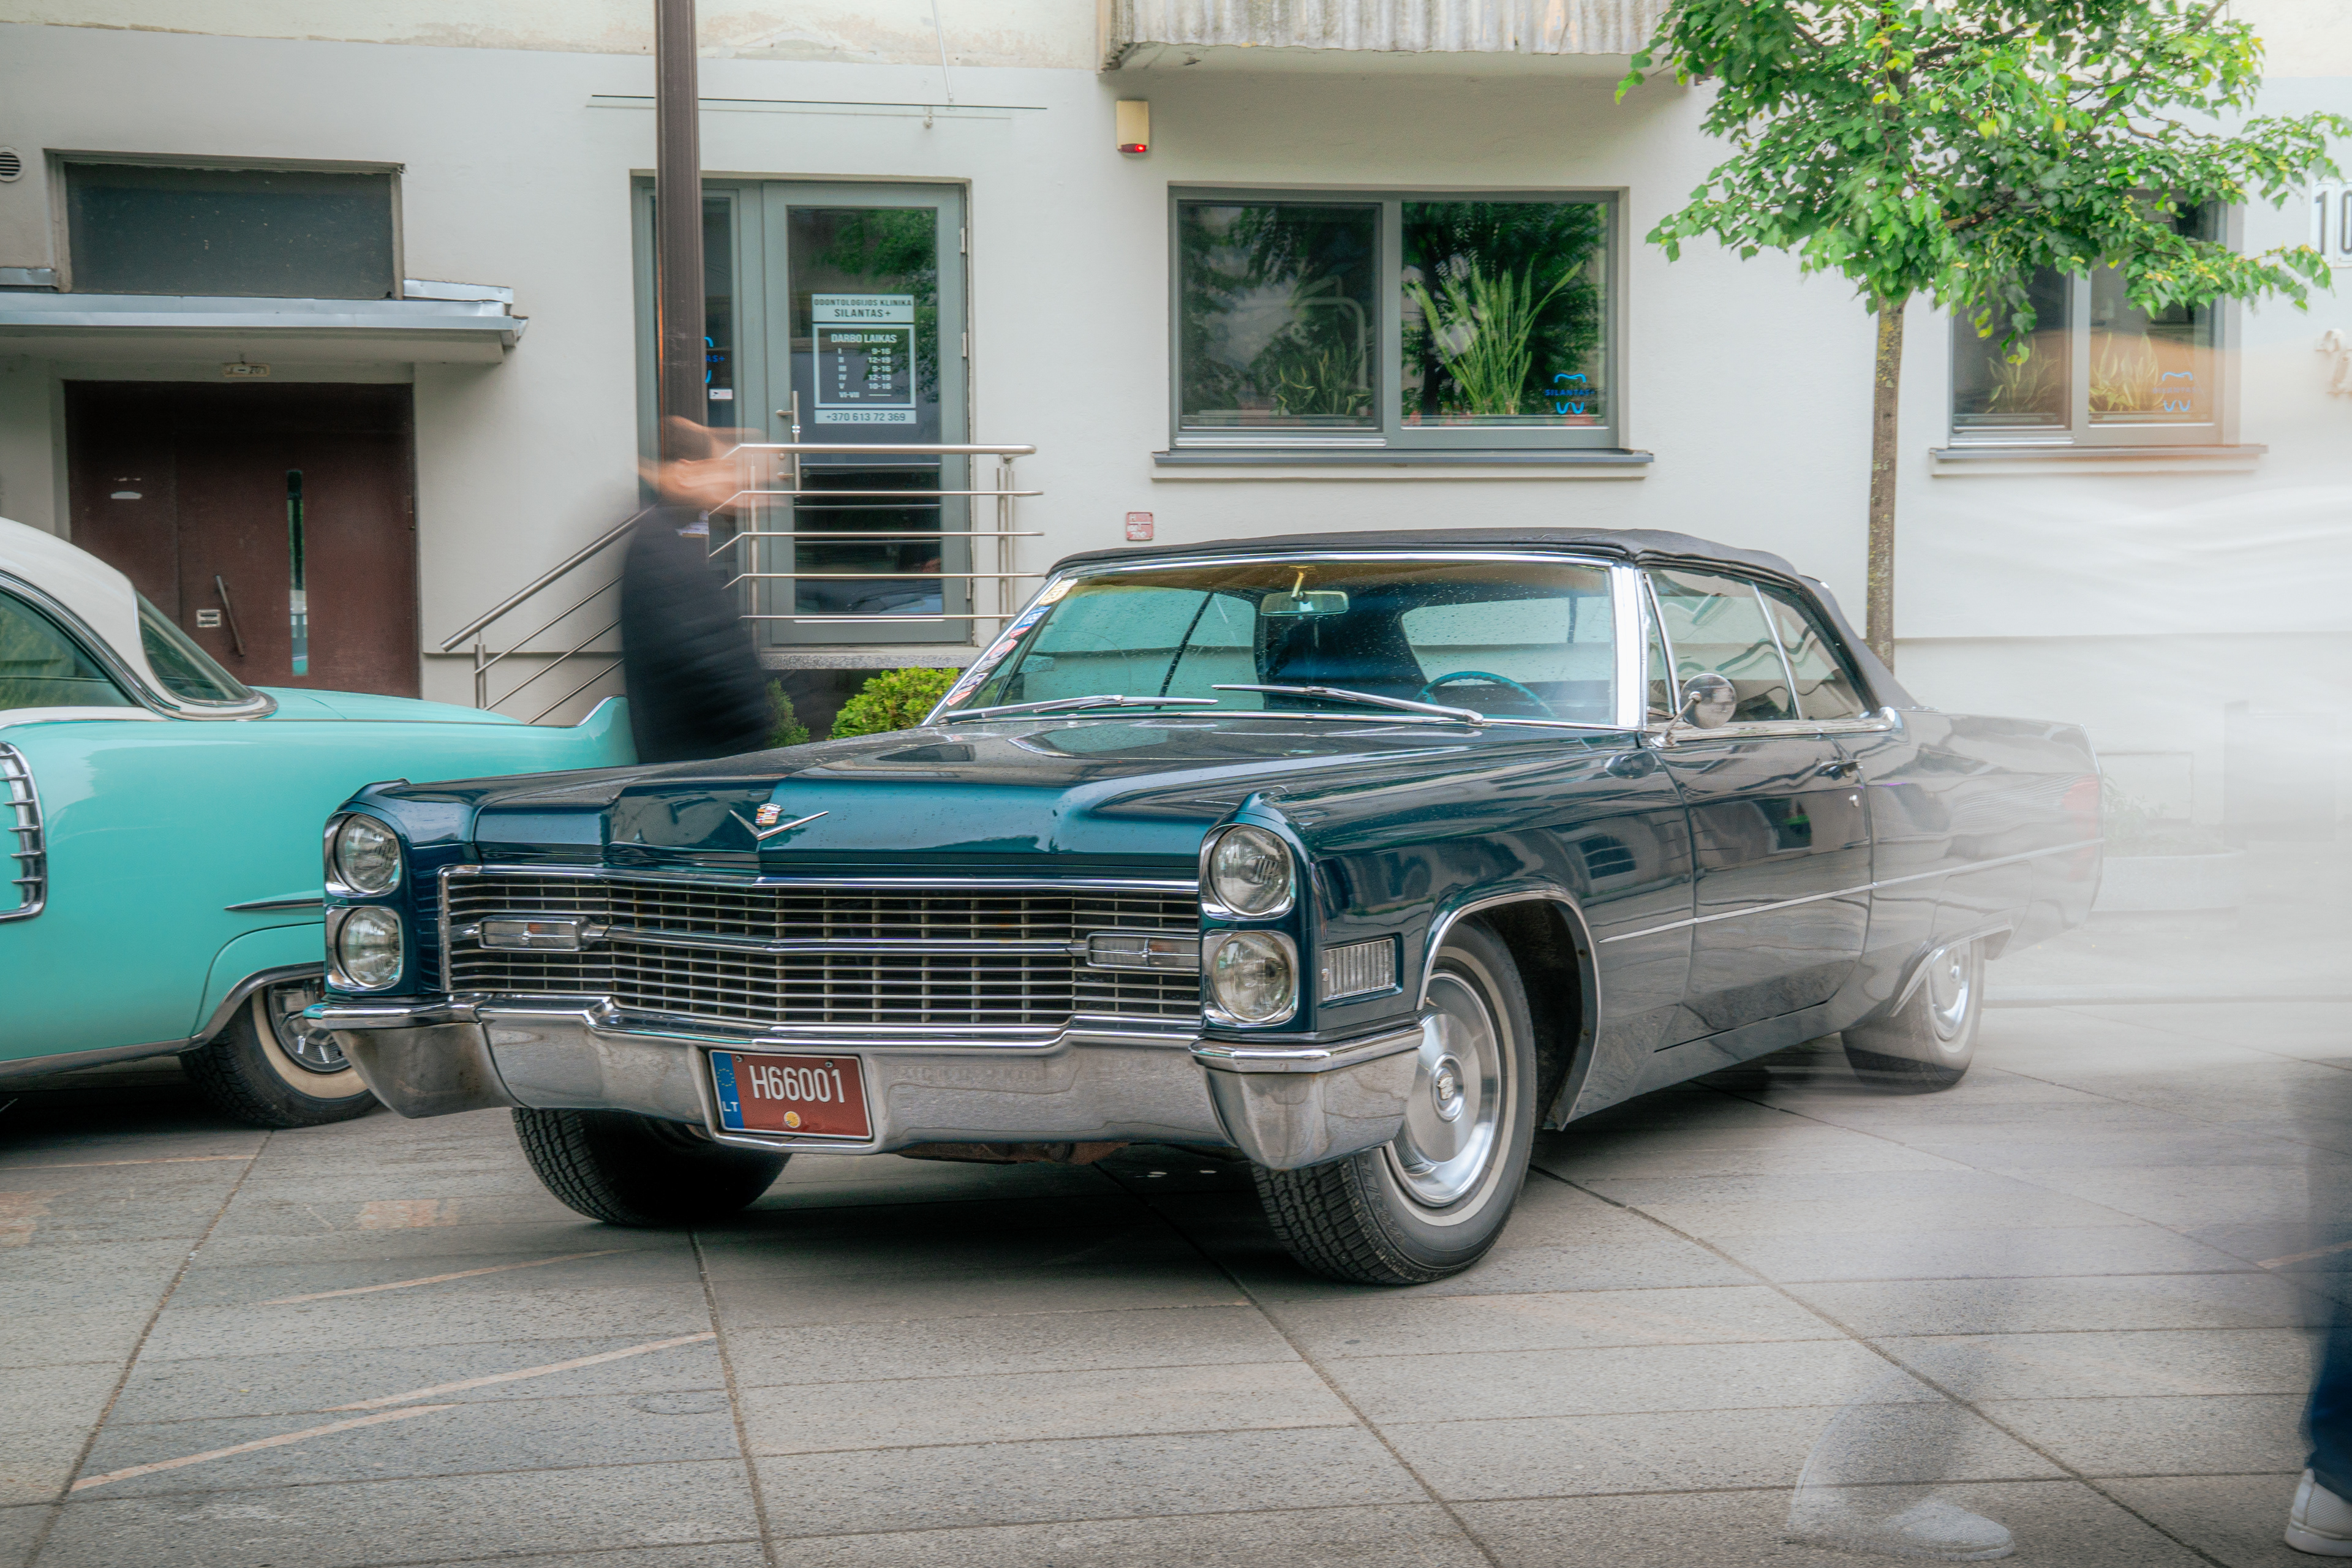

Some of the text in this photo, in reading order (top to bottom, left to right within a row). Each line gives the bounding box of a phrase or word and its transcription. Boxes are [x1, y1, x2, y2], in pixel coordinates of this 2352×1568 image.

[831, 334, 897, 343] DARBO LAIKAS
[826, 413, 906, 421] +370 613 72 369
[748, 1065, 845, 1103] H66001
[721, 1101, 739, 1113] LT
